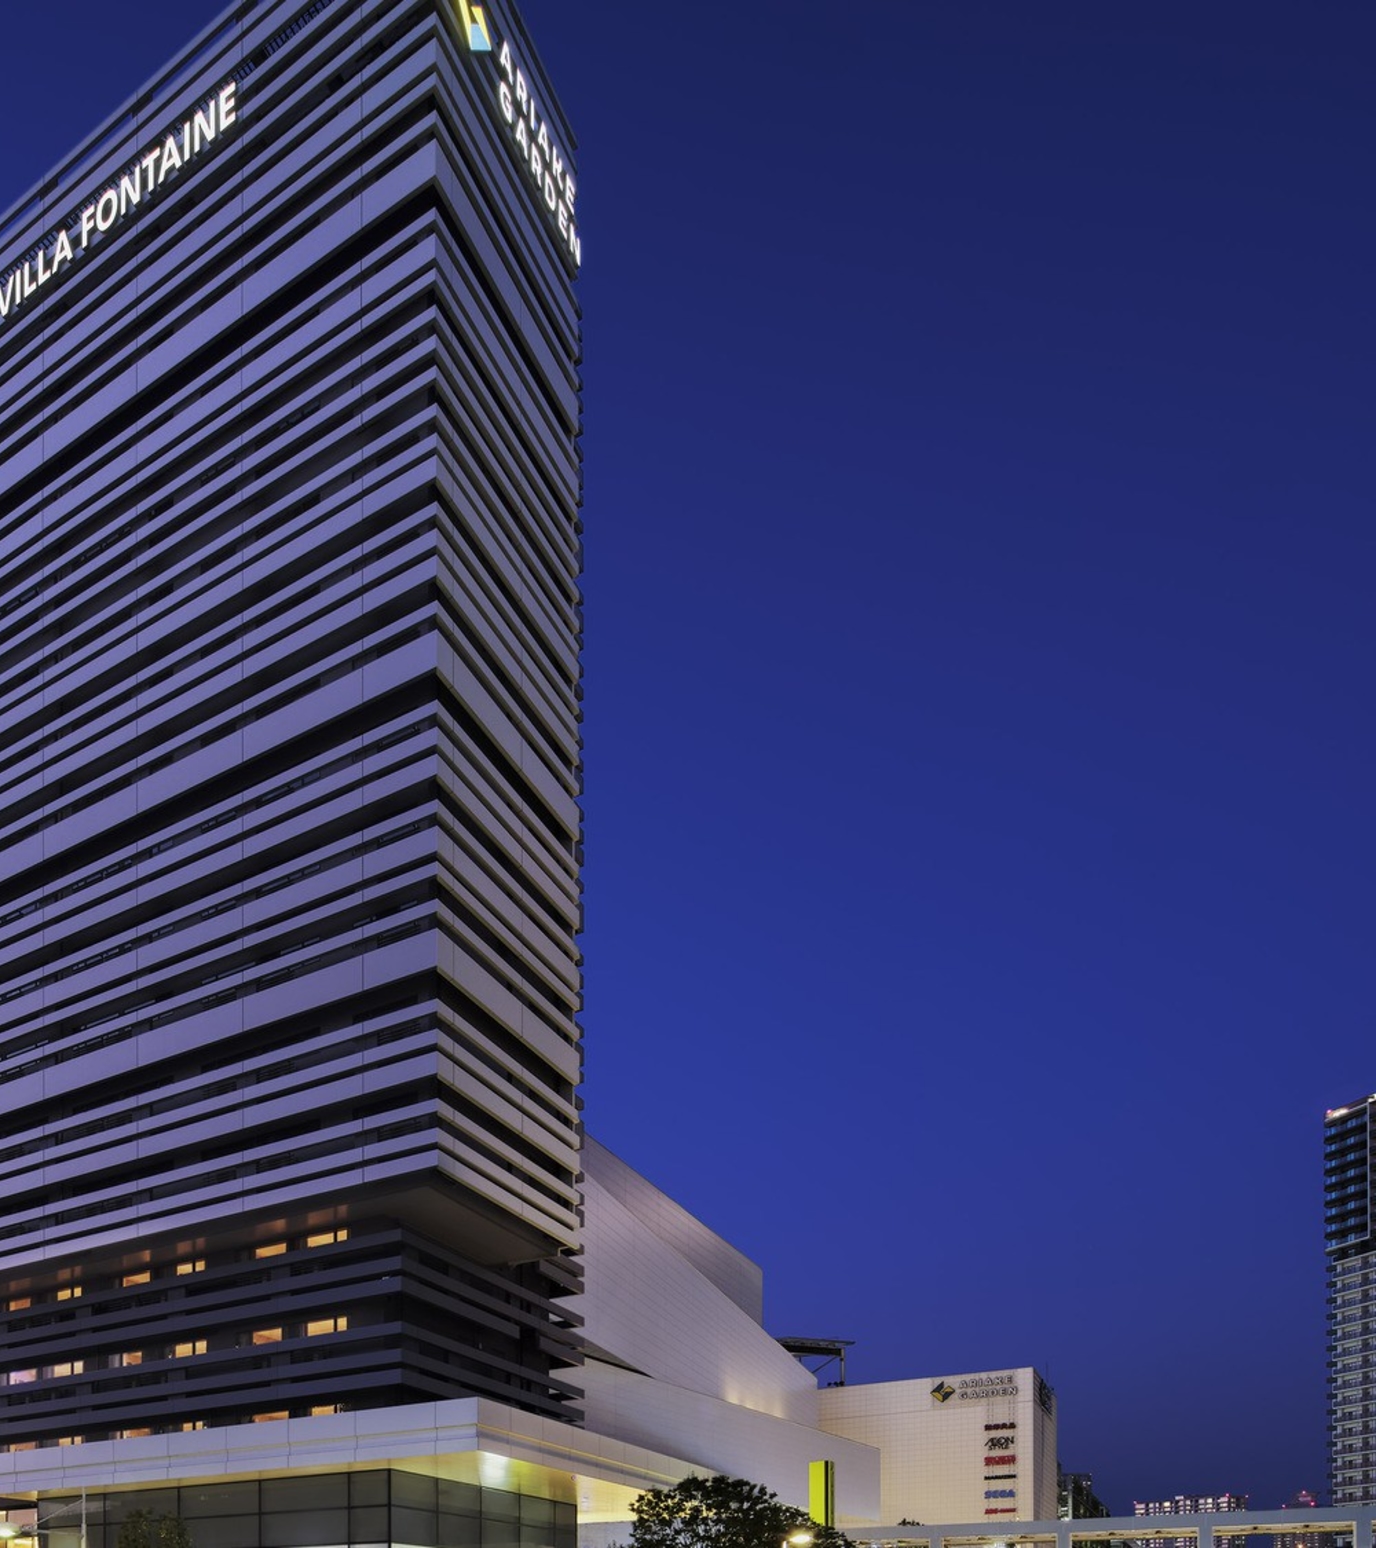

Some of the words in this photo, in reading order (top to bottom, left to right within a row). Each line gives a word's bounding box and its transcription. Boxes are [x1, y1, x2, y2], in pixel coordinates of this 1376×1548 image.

[81, 82, 236, 248] FONTAINE
[499, 40, 576, 215] ARIAKE
[499, 81, 581, 266] GARDEN
[958, 1375, 1013, 1389] ARIAKE
[958, 1386, 1018, 1400] GARDEN
[984, 1489, 1015, 1499] SEGA
